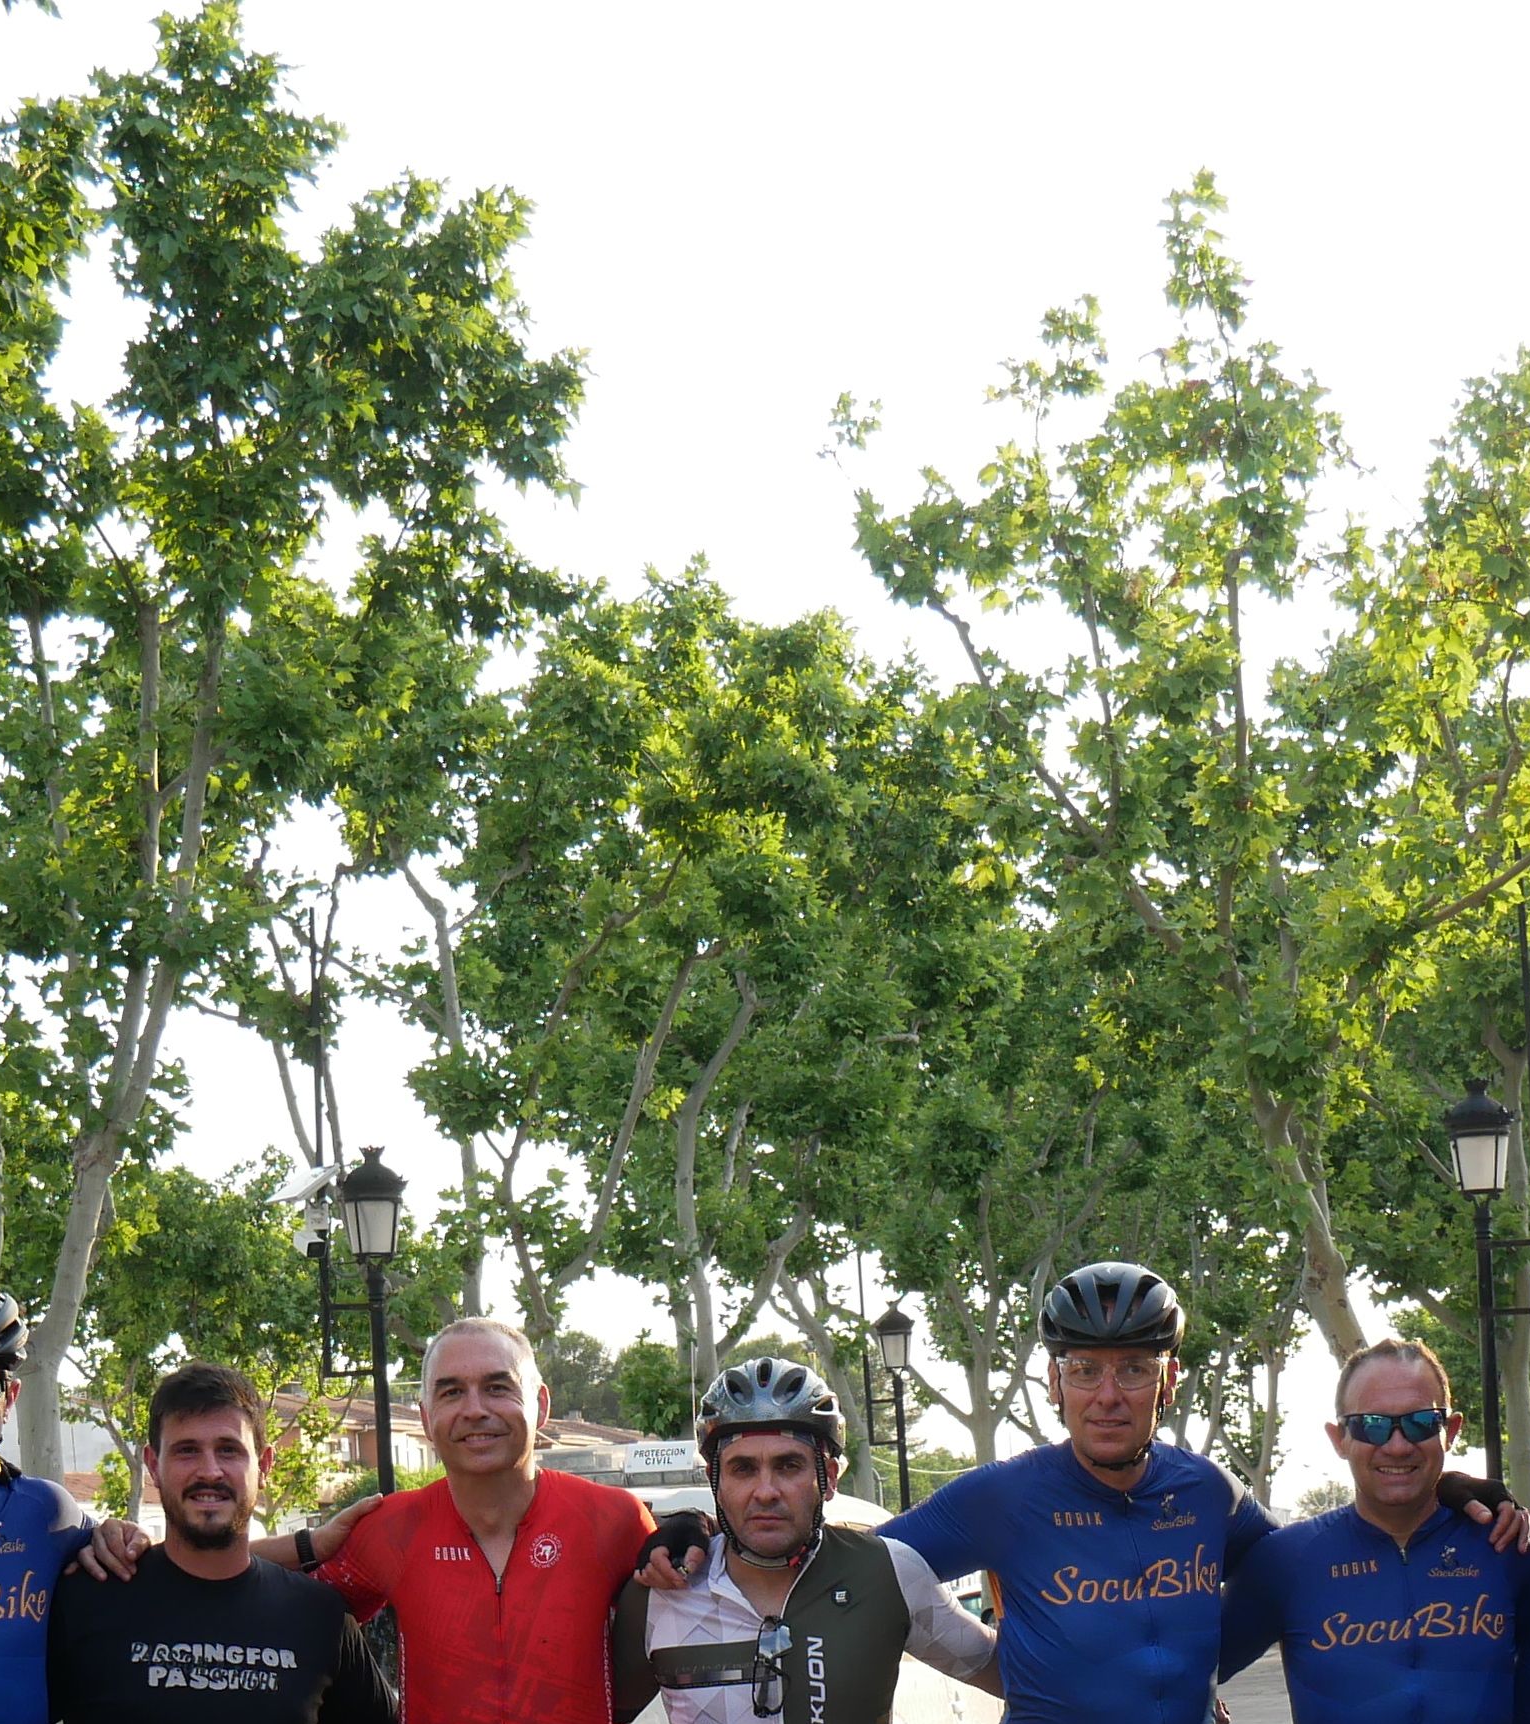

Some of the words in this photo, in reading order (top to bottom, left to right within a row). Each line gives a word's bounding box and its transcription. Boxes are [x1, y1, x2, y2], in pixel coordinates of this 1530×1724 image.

[634, 1448, 686, 1458] PROTECCION
[645, 1457, 673, 1465] CIVIL
[1053, 1511, 1103, 1527] GOBIK
[434, 1546, 471, 1561] GOBIK
[1040, 1544, 1217, 1605] SocuBike
[1331, 1560, 1379, 1578] GOBIK
[1311, 1594, 1505, 1651] SocuBike
